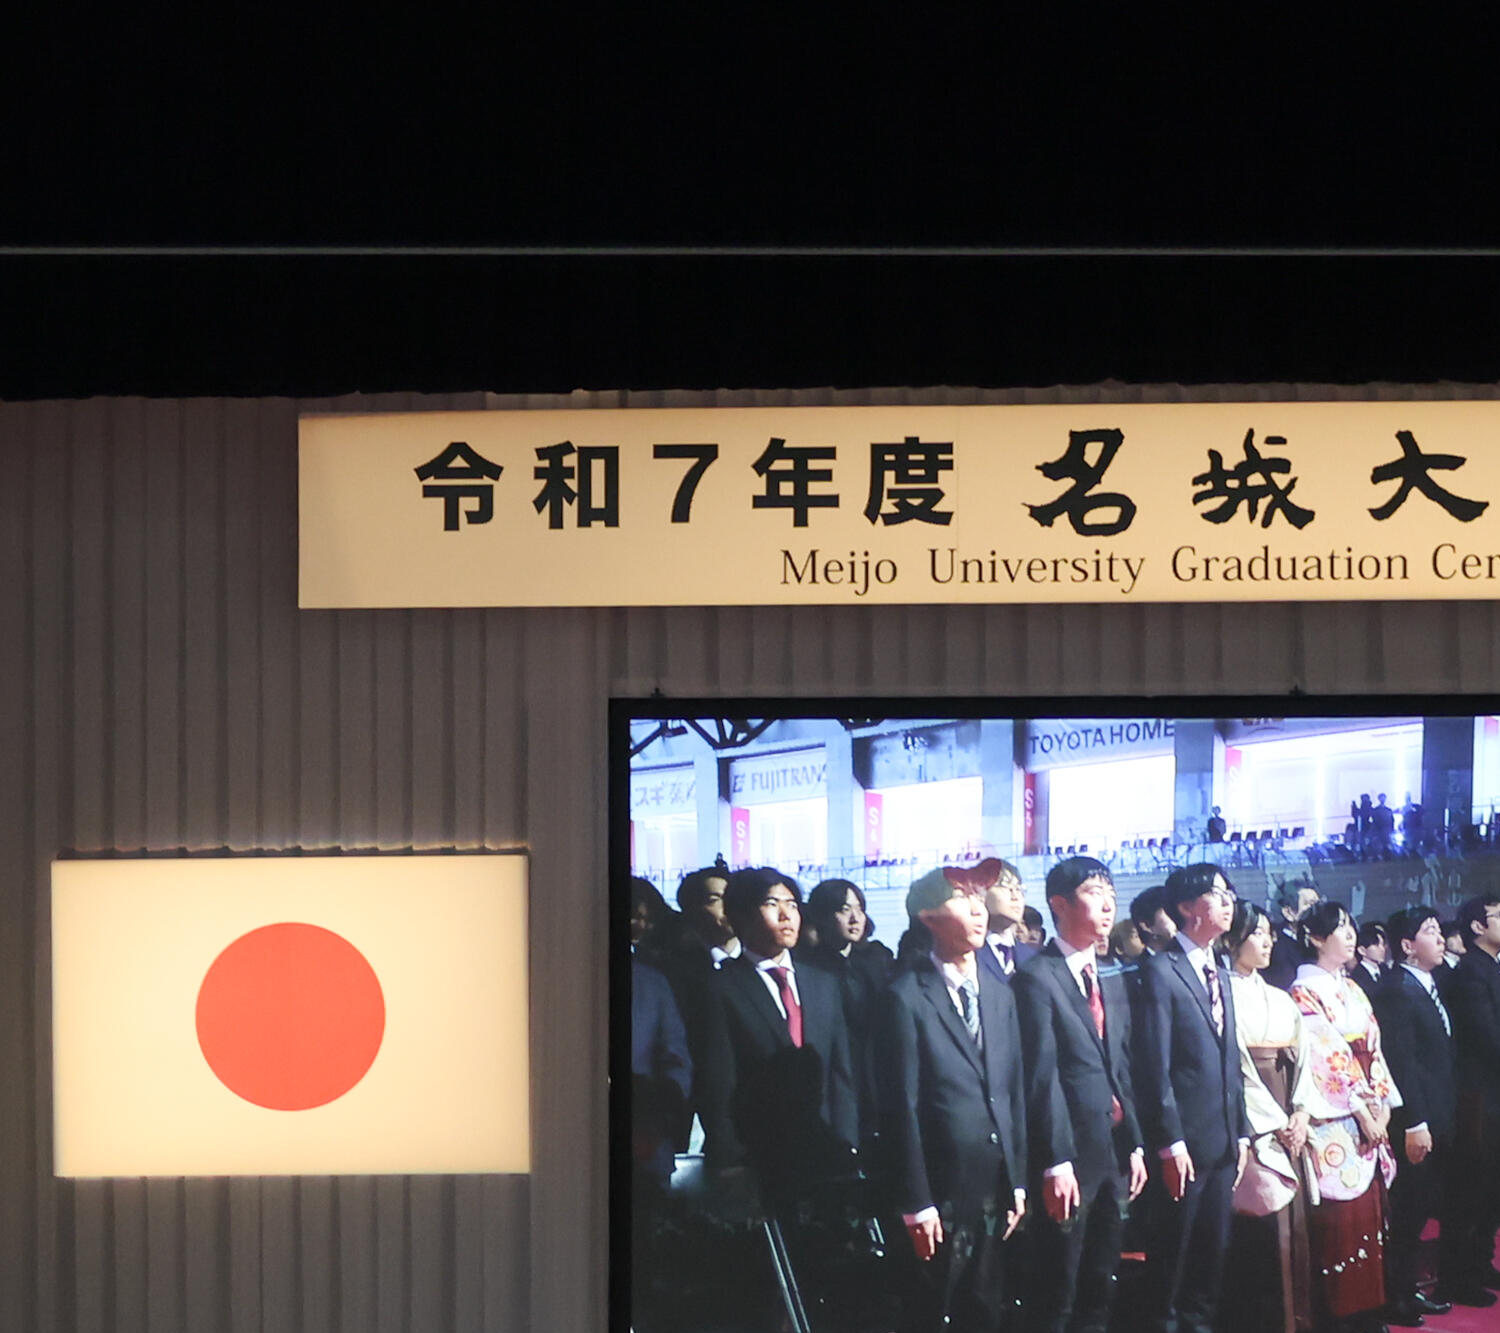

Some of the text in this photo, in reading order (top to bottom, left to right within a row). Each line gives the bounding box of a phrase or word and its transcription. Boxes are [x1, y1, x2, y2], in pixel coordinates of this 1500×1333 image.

[780, 548, 898, 597] Meijo
[928, 548, 1145, 594] University
[1171, 544, 1409, 582] Graduation
[1030, 720, 1174, 755] TOYOTA HOME
